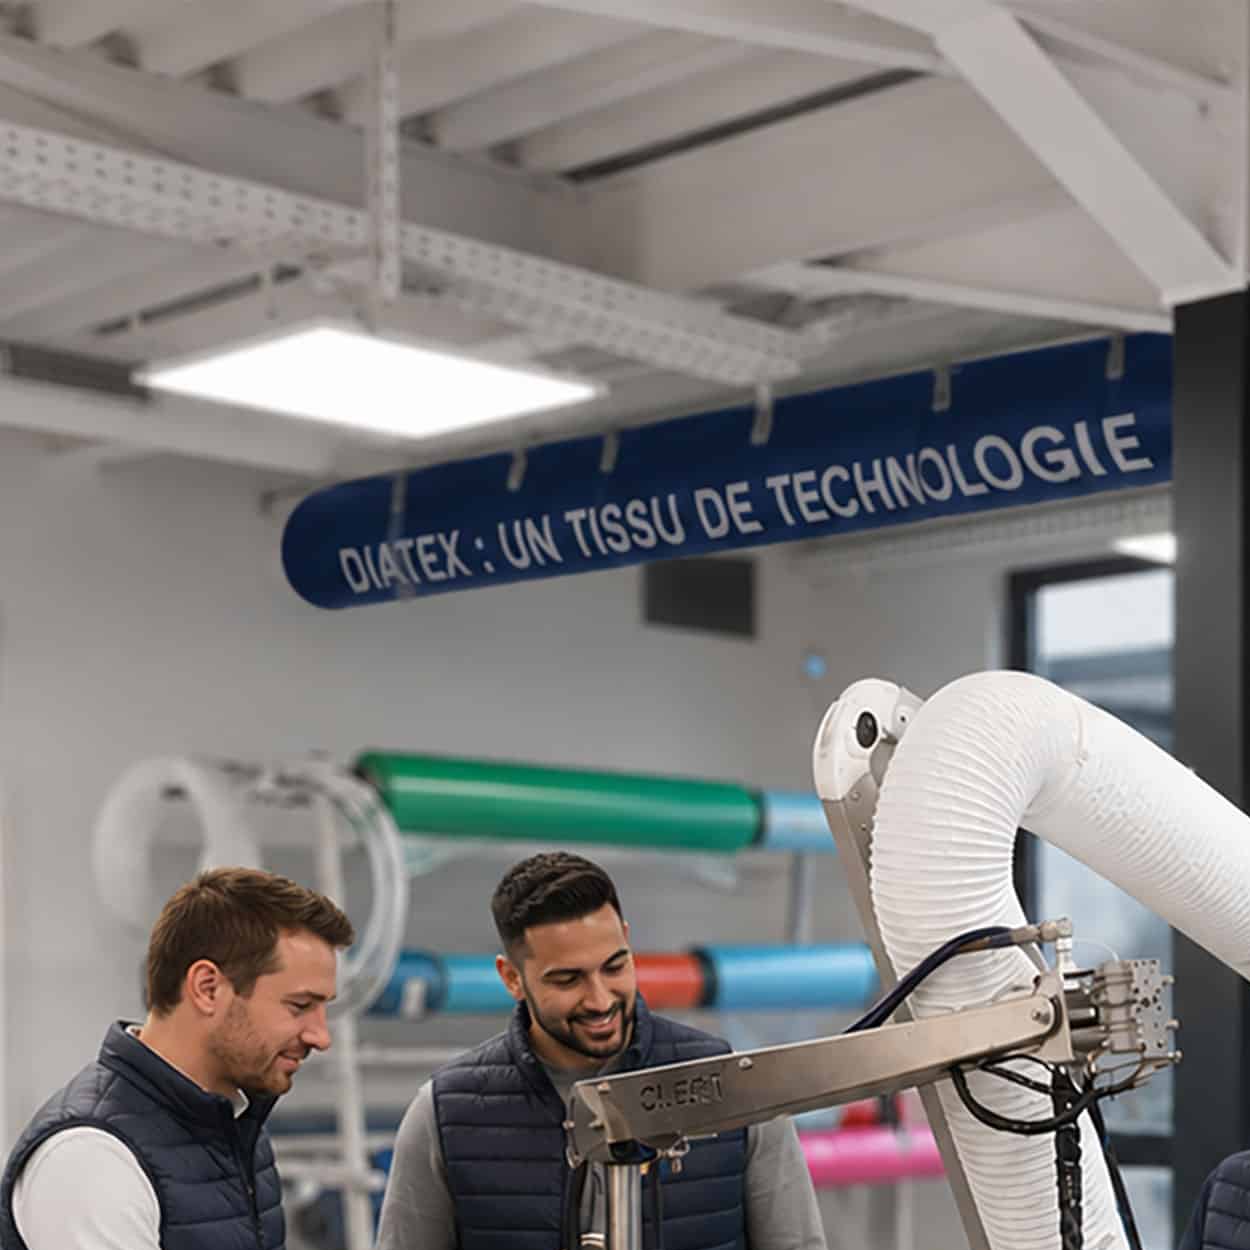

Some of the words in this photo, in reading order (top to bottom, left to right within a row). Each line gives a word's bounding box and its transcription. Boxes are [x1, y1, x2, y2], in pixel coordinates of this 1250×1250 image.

[338, 530, 473, 593] DIATEX
[498, 514, 563, 569] UN
[564, 494, 686, 558] TISSU
[694, 481, 764, 540] DE
[765, 412, 1154, 529] TECHNOLOGIE
